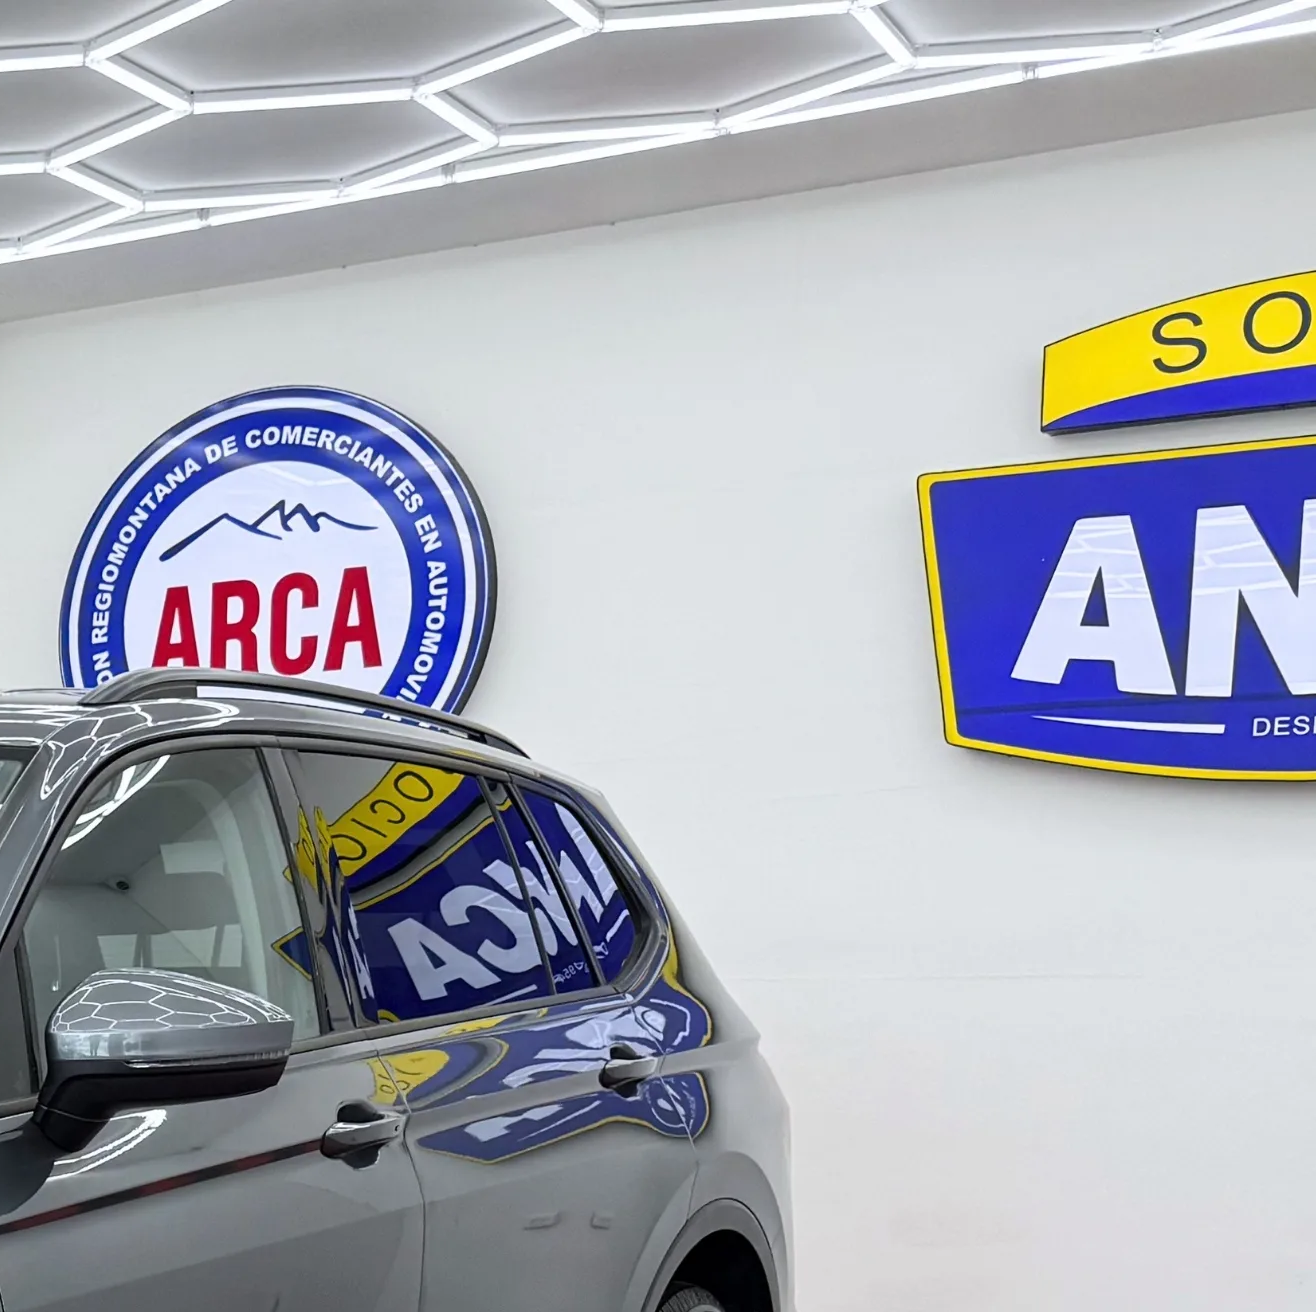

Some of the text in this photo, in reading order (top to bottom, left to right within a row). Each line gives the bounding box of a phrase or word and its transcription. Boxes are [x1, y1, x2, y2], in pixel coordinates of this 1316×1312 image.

[1151, 291, 1313, 374] SO
[205, 435, 239, 465] DE
[245, 425, 423, 514] COMERCIANTES
[91, 457, 202, 645] REGIOMONTANA
[414, 516, 443, 554] EN
[151, 566, 383, 676] ARCA
[396, 561, 448, 702] AUTOMOVI
[1252, 715, 1316, 737] DES
